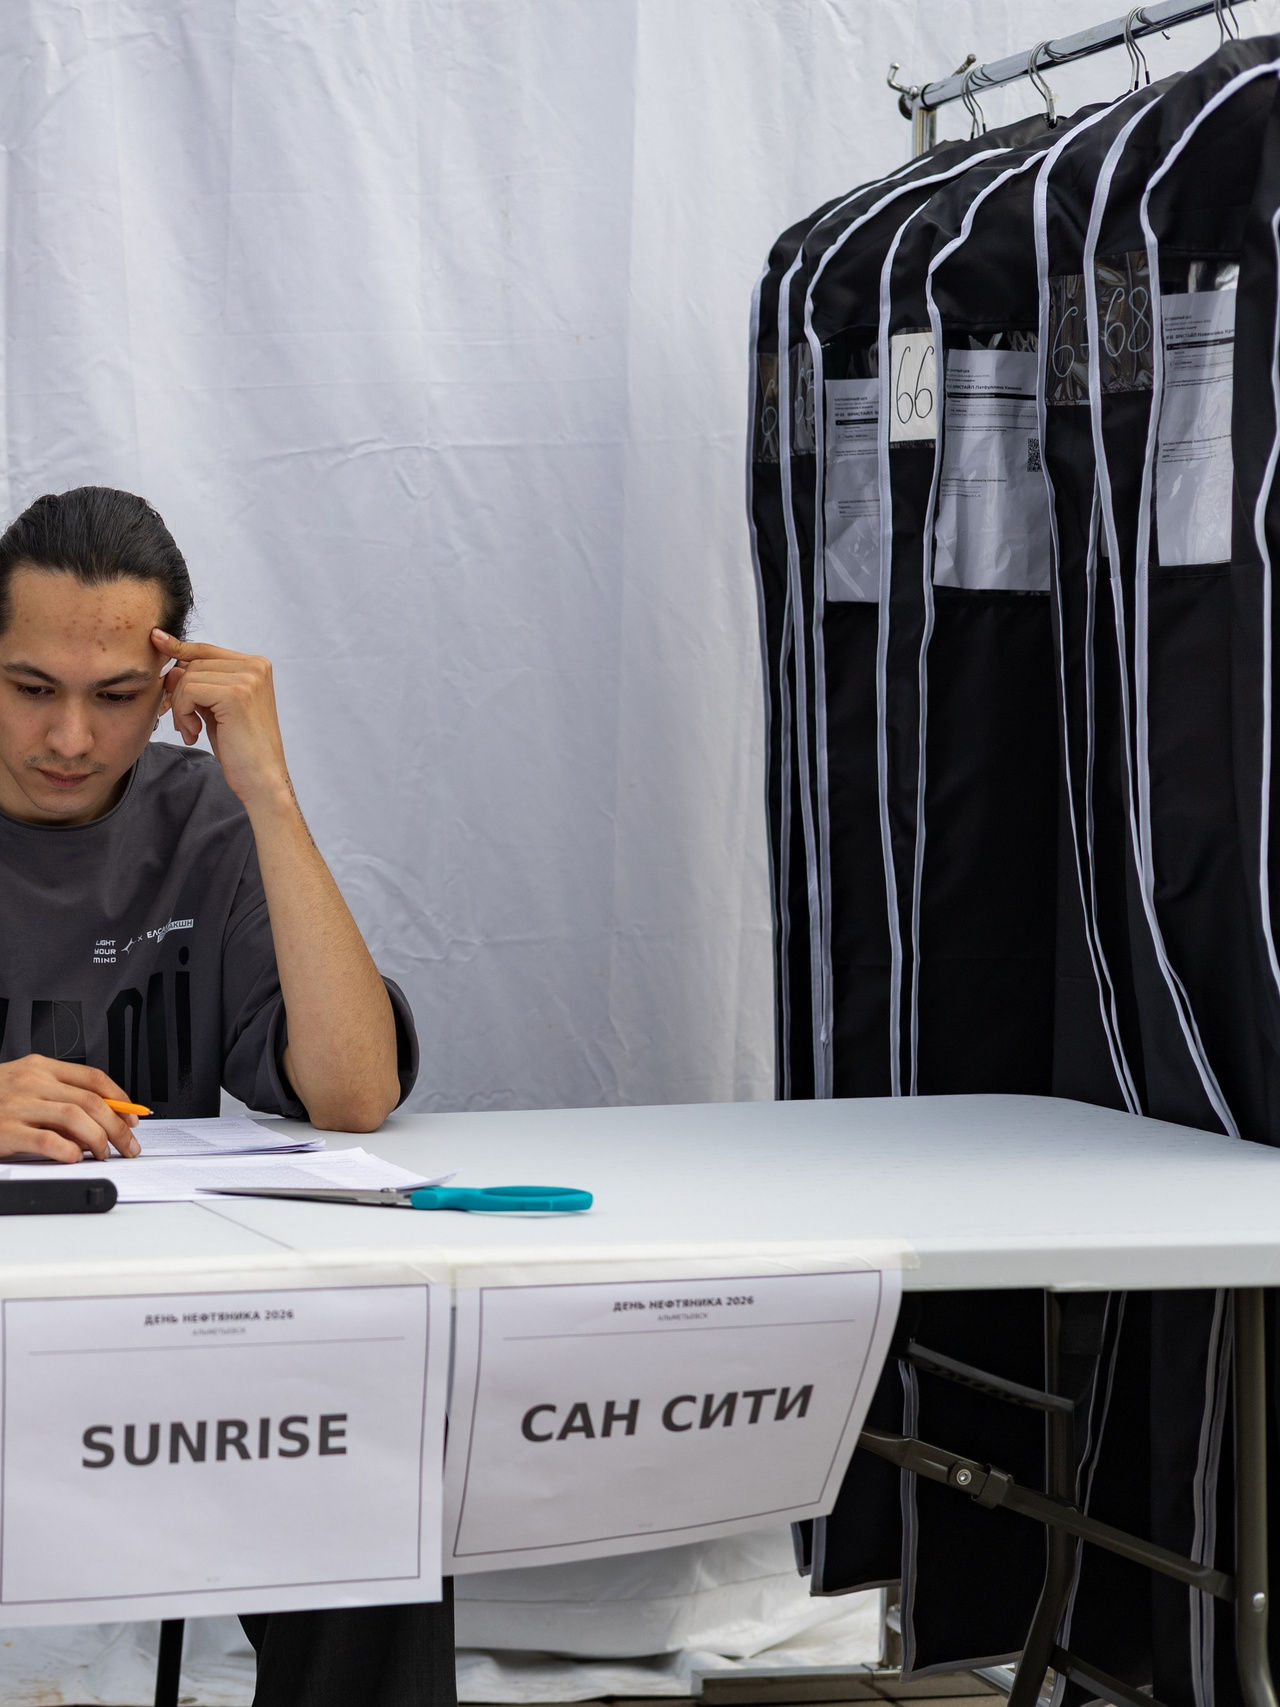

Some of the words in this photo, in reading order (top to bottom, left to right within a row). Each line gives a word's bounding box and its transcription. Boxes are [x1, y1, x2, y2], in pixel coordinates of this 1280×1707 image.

[1051, 305, 1090, 378] 6
[1104, 286, 1151, 358] 68
[761, 378, 778, 437] 6
[895, 345, 935, 424] 66
[144, 1313, 179, 1326] ДЕНЬ
[182, 1310, 260, 1323] НЕФТЯНИКА
[264, 1309, 295, 1320] 2026
[613, 1301, 645, 1313] ДЕНЬ
[649, 1297, 722, 1310] НЕФТЯНИКА
[726, 1296, 754, 1306] 2026
[82, 1413, 349, 1469] SUNRISE
[521, 1398, 641, 1443] САН
[661, 1384, 814, 1433] СИТИ
